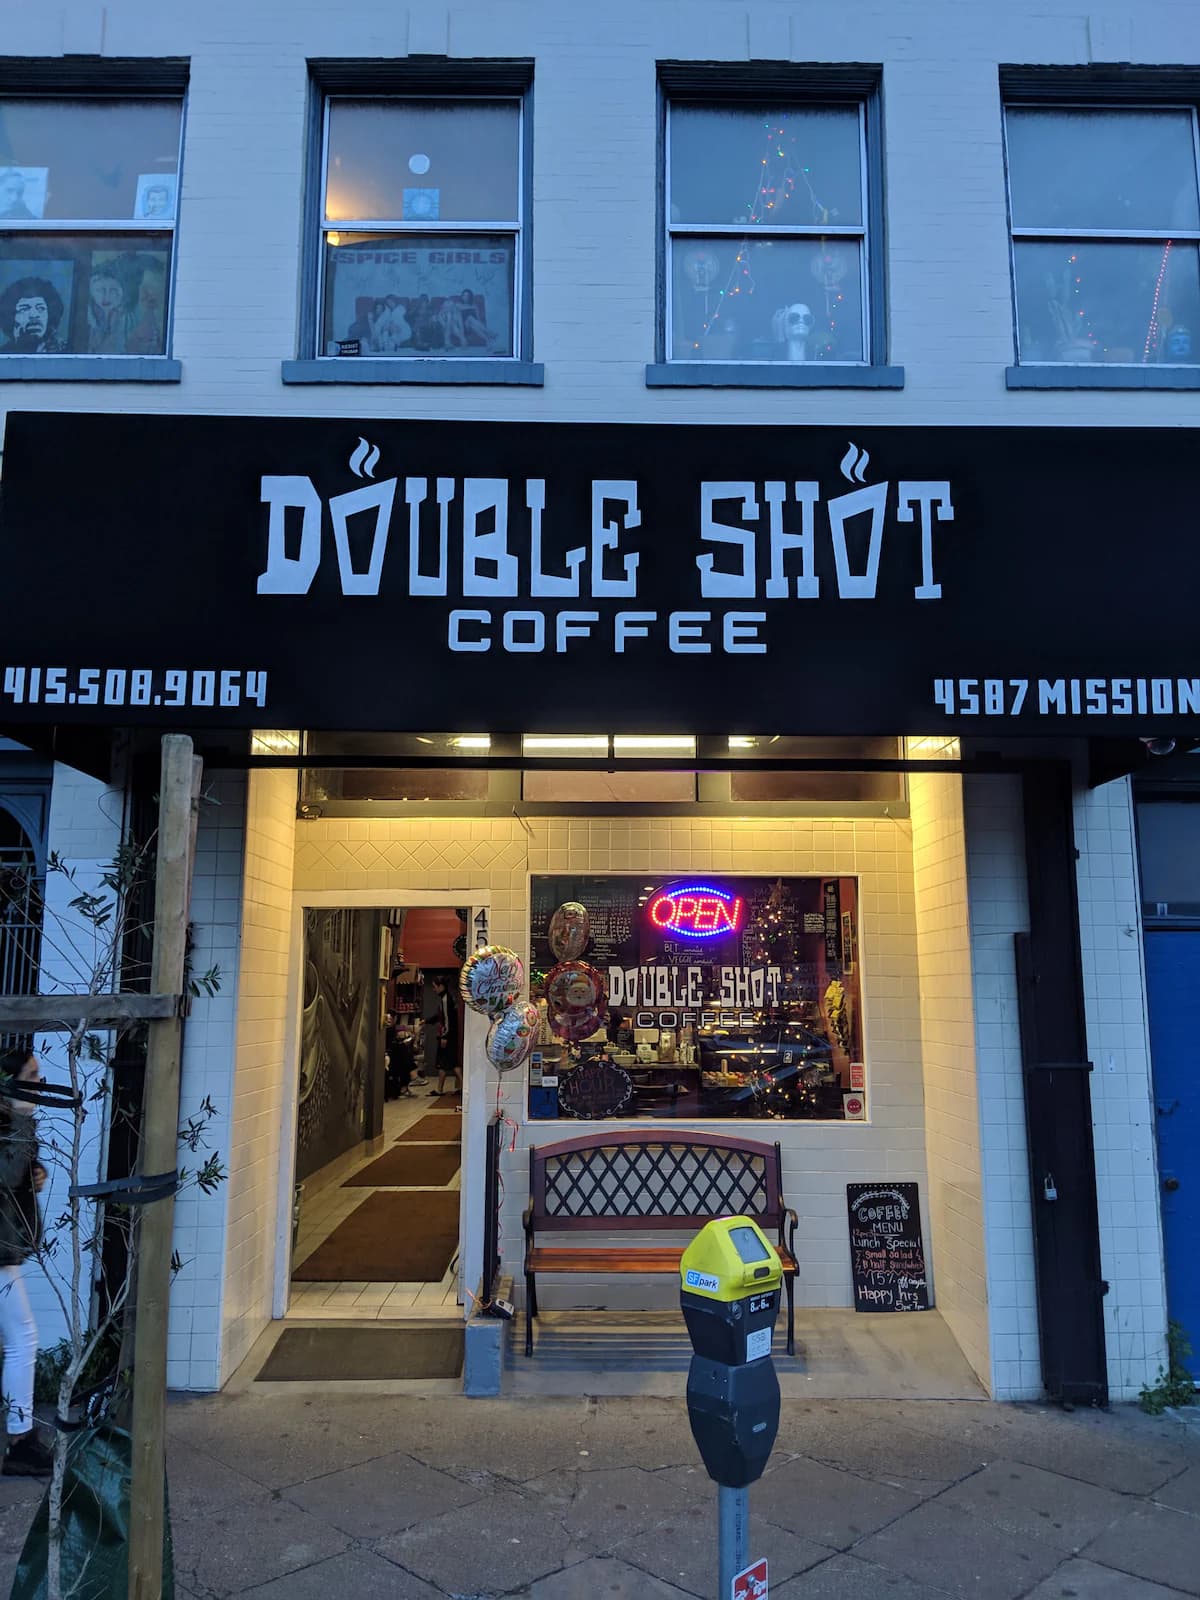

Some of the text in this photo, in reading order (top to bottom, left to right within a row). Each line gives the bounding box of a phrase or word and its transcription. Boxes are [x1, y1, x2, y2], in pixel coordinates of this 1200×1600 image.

[335, 252, 506, 265] SPICE GIRLS
[256, 474, 955, 600] DOUBLE SHOT
[448, 609, 767, 654] COFFEE
[3, 666, 268, 707] 415.508.9064
[934, 678, 1200, 716] 4587 MISSION
[651, 896, 741, 930] OPEN
[607, 965, 782, 1008] DOUBLE SHOT
[636, 1012, 755, 1029] COFFEE
[858, 1205, 909, 1222] COFFEE
[872, 1222, 904, 1233] MENU
[852, 1236, 921, 1251] Lunch Special
[871, 1272, 896, 1286] 15%
[858, 1284, 919, 1305] Happy hrs
